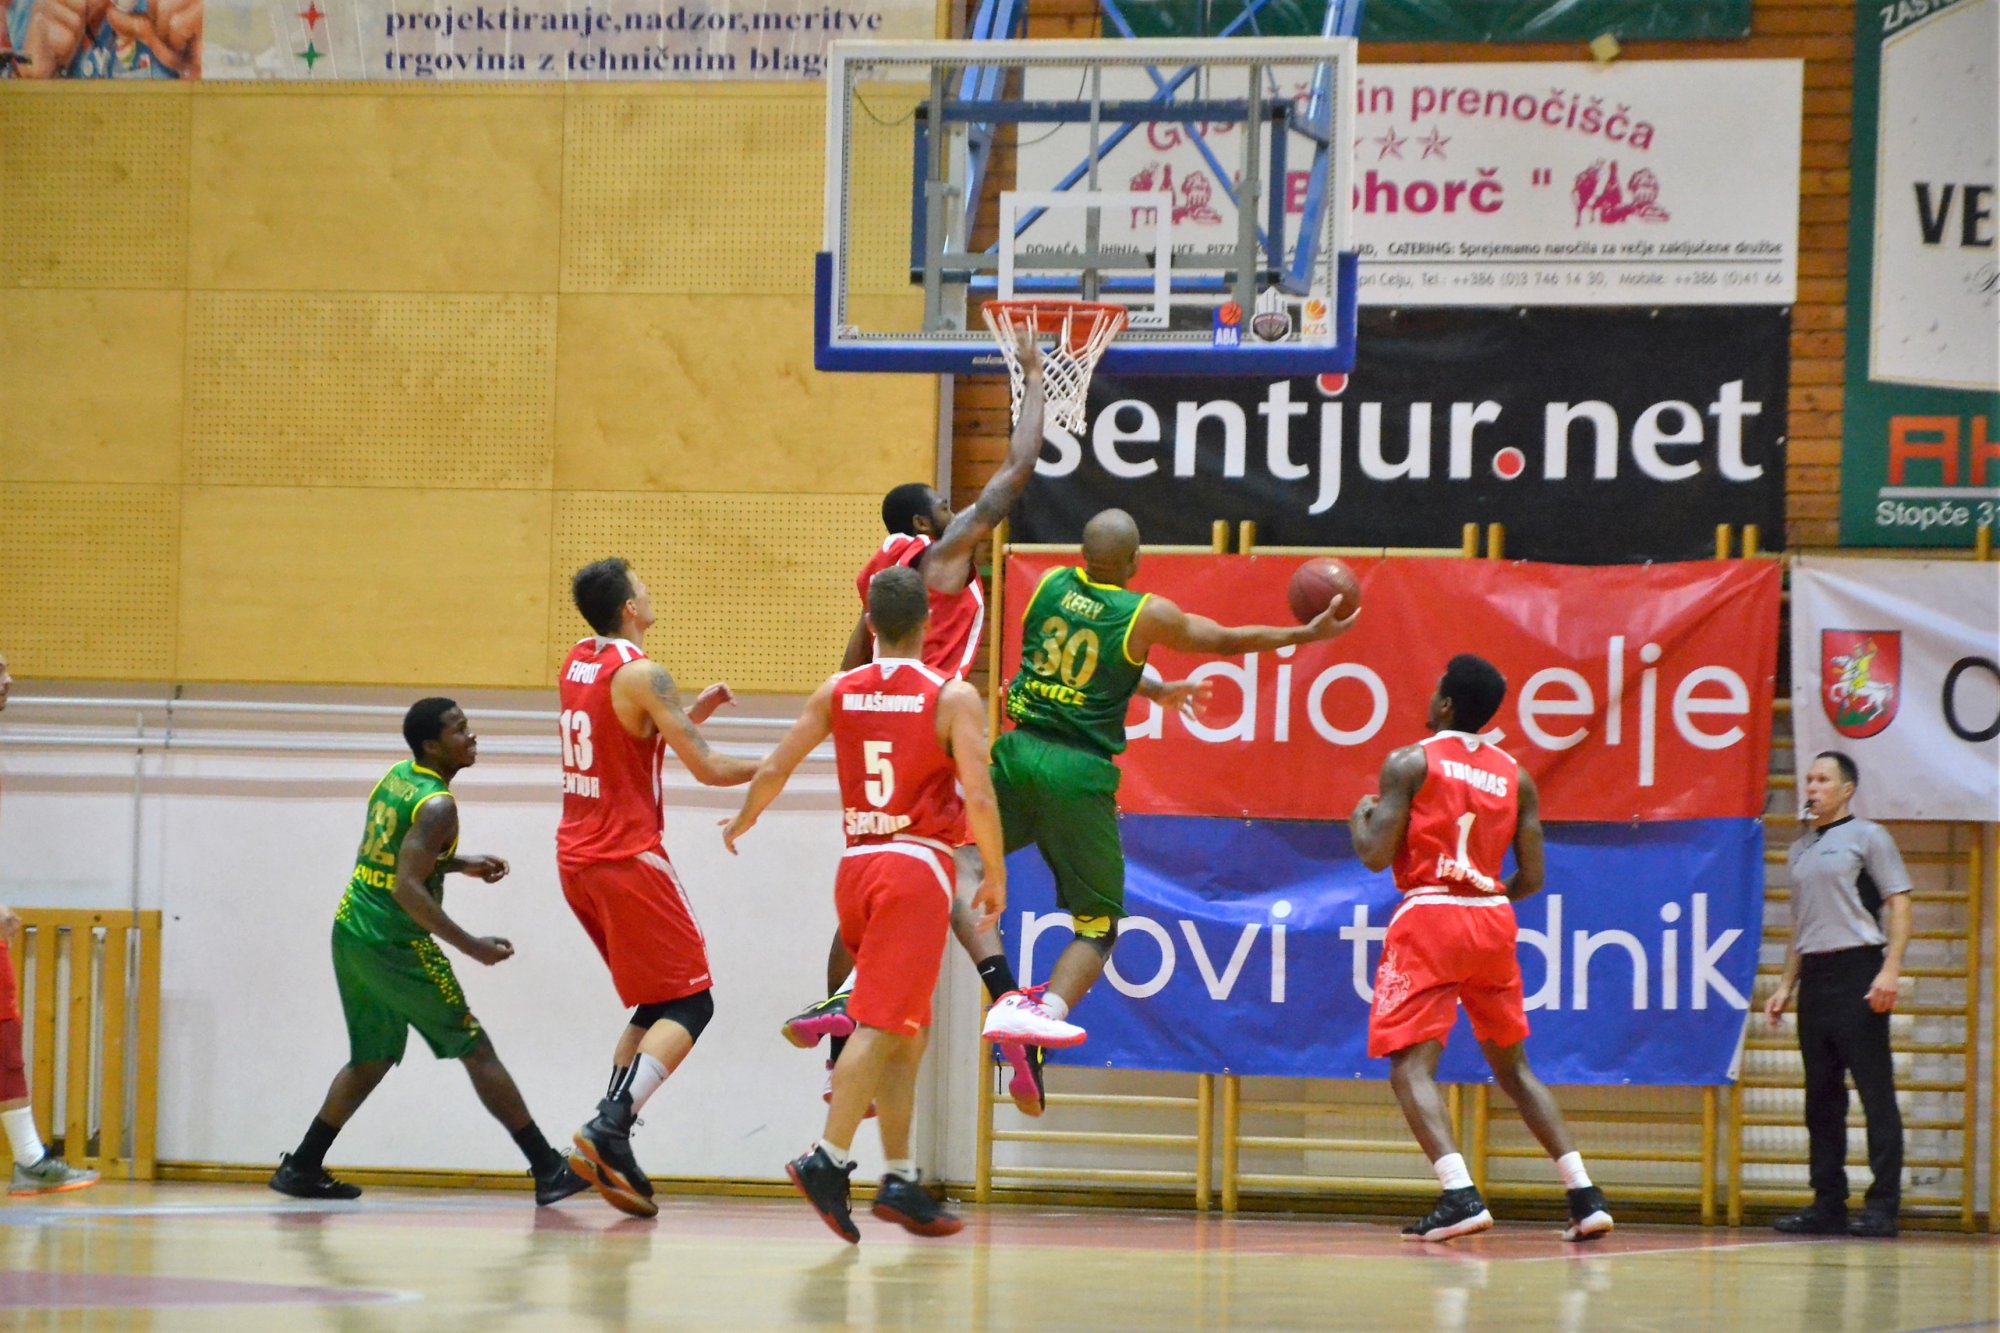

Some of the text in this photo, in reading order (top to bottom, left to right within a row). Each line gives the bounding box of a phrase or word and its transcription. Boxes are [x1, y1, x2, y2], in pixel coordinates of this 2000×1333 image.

[385, 46, 836, 76] trgovina z tehničnim blag
[1356, 79, 1655, 150] in prenočišča
[1286, 166, 1504, 213] Bhorč
[1876, 500, 1970, 531] Stopče
[1033, 616, 1099, 689] 30
[560, 709, 593, 771] 13
[1125, 635, 1750, 786] adio elje
[863, 740, 895, 808] 5
[1440, 759, 1508, 798] THOMAS
[359, 801, 398, 867] 32
[1457, 812, 1477, 868] 1
[1340, 893, 1750, 1011] tdnik
